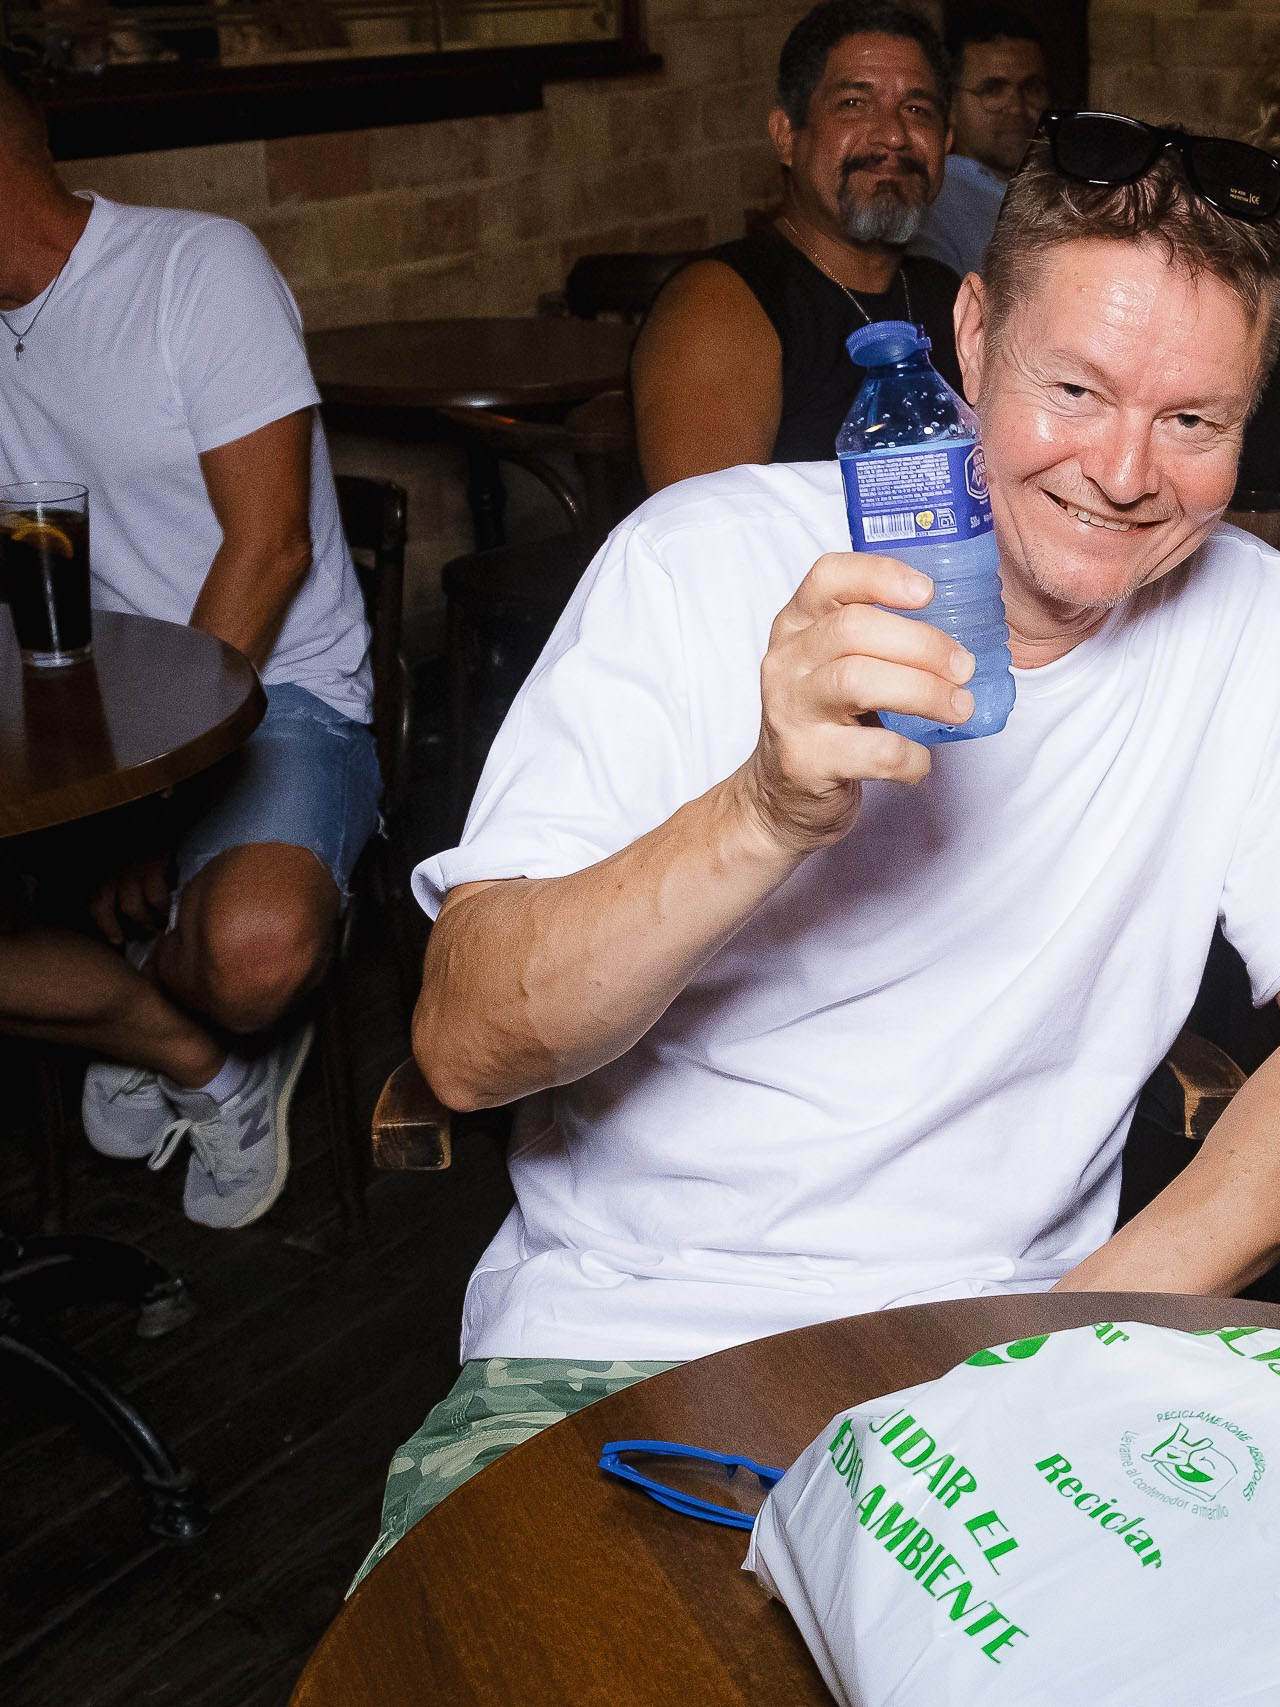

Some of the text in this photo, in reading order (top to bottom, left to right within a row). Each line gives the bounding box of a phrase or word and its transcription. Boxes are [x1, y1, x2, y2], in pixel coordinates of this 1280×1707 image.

[963, 1509, 1020, 1576] EL
[1034, 1452, 1162, 1570] Reciclar
[857, 1483, 1030, 1664] AMBIENTE
